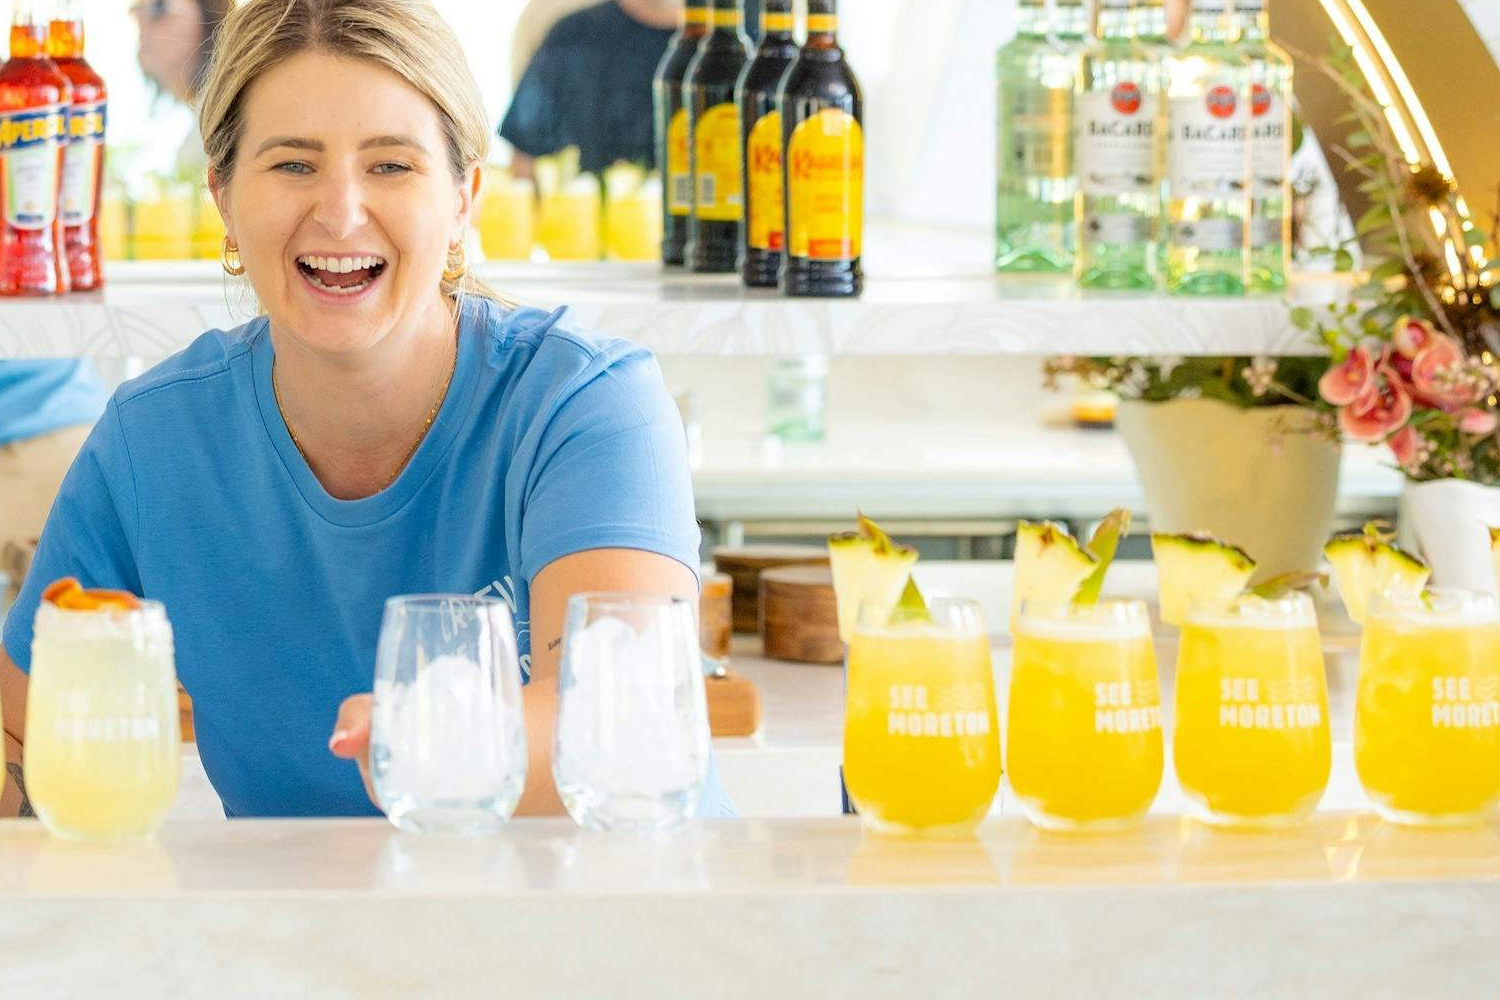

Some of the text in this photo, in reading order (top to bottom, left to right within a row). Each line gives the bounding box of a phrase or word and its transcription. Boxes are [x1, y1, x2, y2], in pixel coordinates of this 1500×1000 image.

[888, 684, 928, 709] SEE
[1094, 681, 1132, 706] SEE
[1220, 677, 1260, 701] SEE
[1431, 676, 1470, 701] SEE
[887, 711, 990, 737] MORETON
[1219, 703, 1321, 729] MORETON
